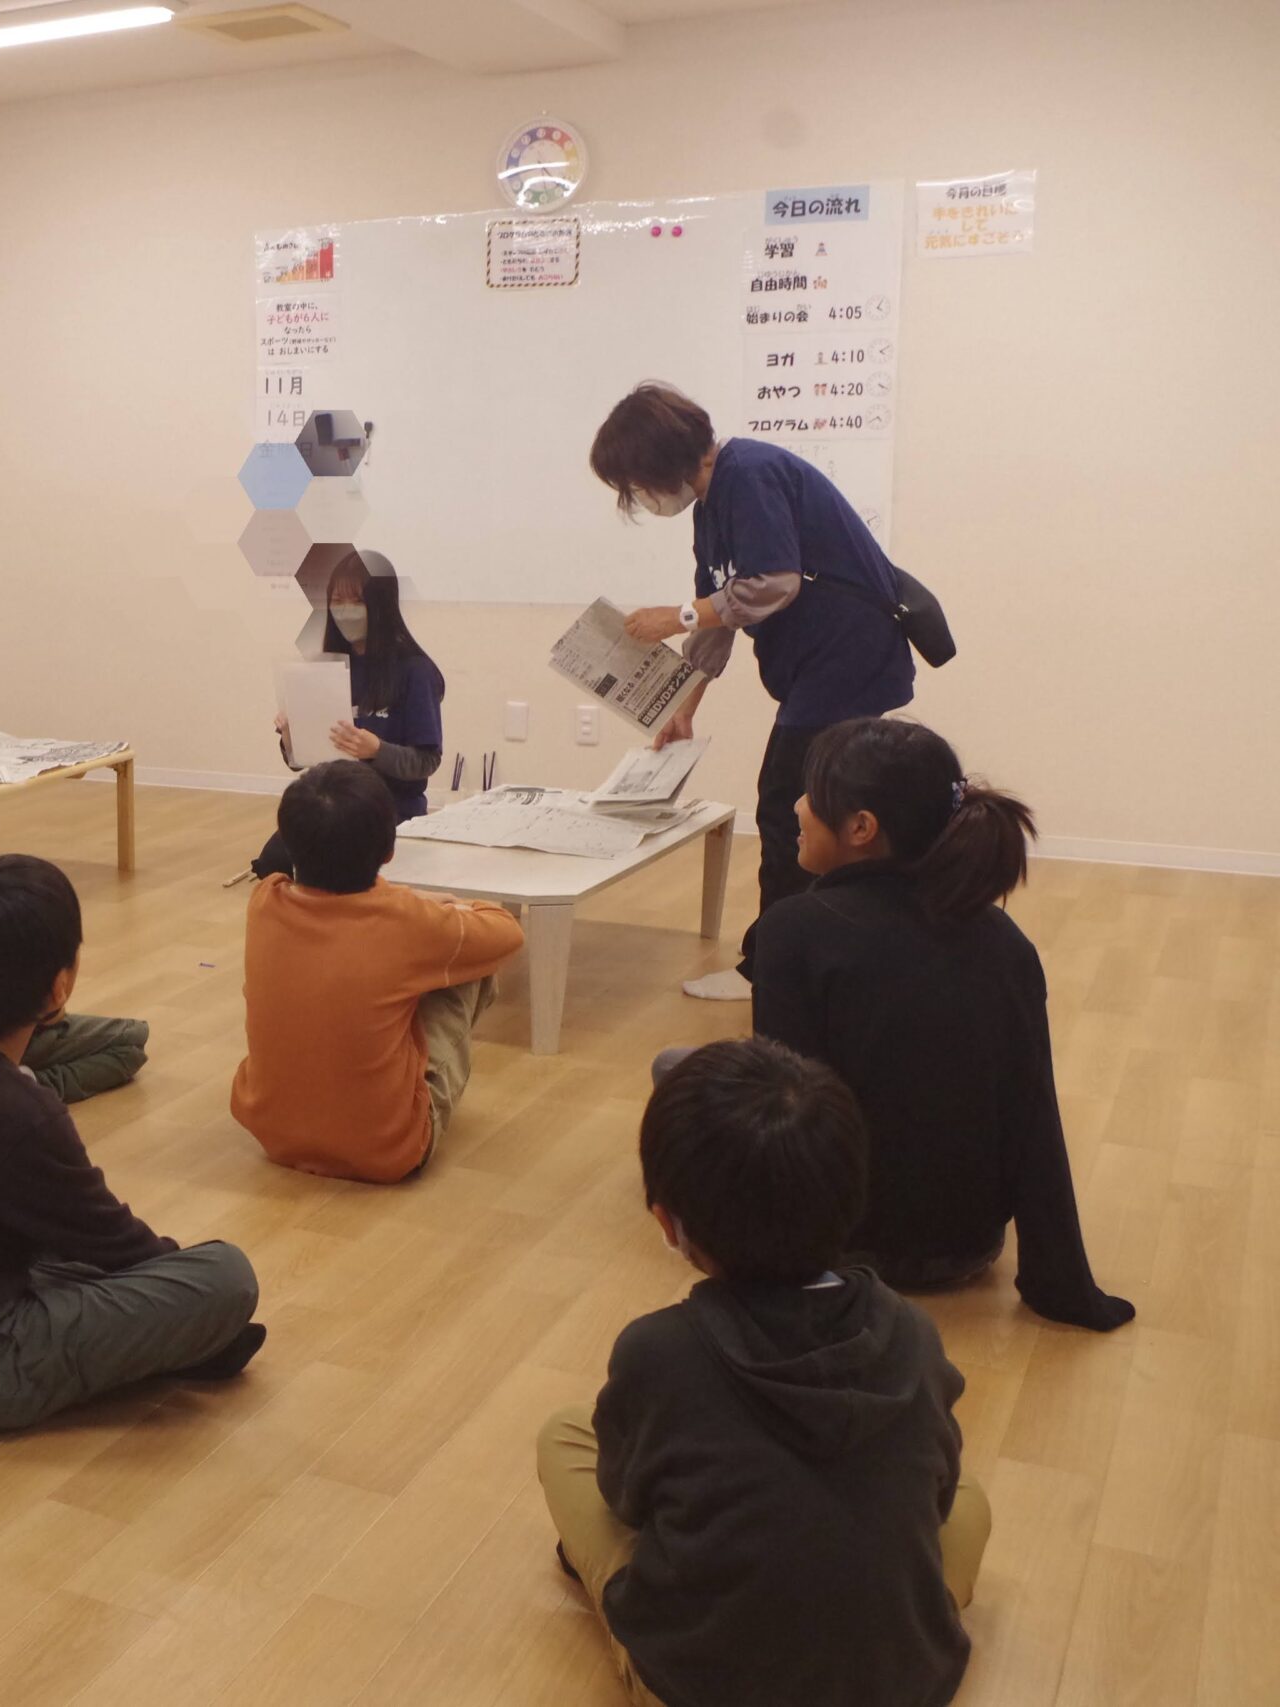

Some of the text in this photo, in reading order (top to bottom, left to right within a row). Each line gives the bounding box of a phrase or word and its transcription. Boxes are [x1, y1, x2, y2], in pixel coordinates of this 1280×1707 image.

[772, 197, 861, 218] 今日の流れ
[764, 243, 795, 259] 学習
[750, 276, 807, 292] 自由時間
[746, 306, 862, 324] 始まりの会 4:05
[766, 349, 865, 367] ヨガ 4:10
[265, 376, 302, 395] 11月
[757, 382, 863, 400] おやつ 4:20
[267, 409, 305, 426] 14日
[829, 415, 863, 429] 4:40
